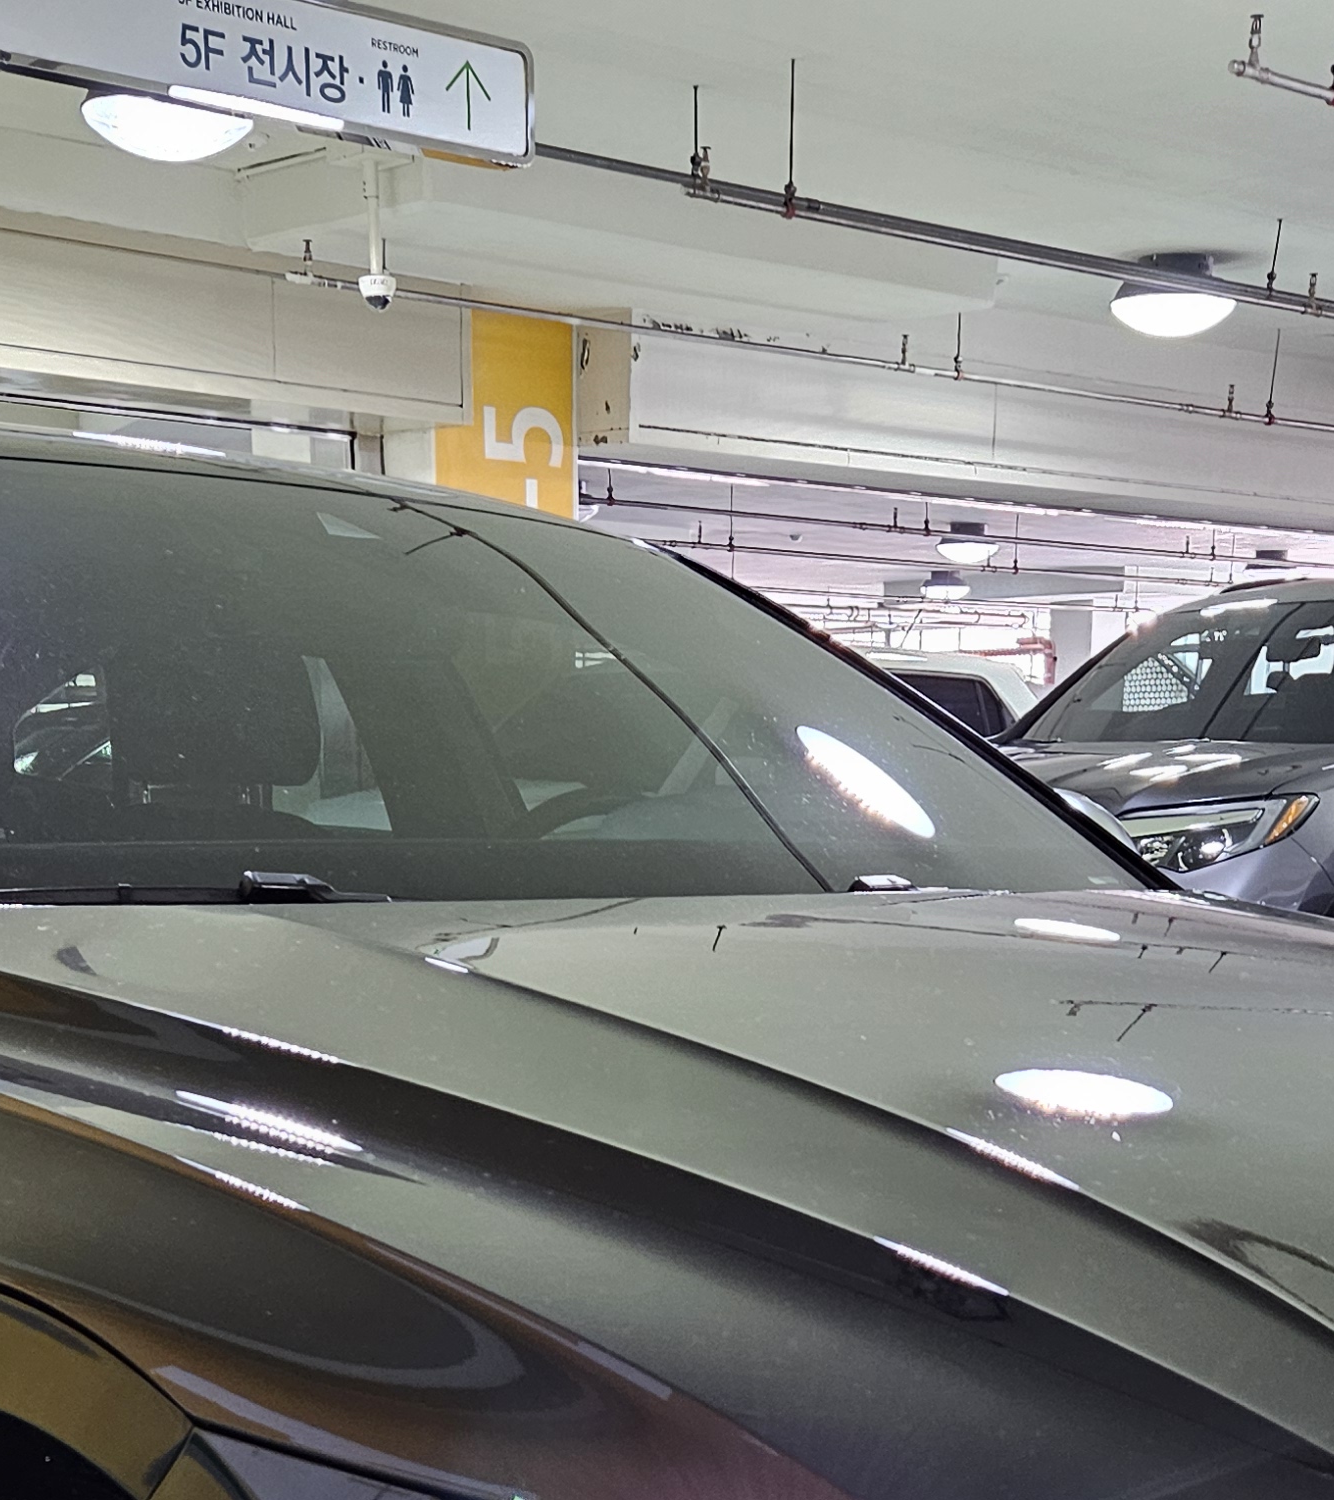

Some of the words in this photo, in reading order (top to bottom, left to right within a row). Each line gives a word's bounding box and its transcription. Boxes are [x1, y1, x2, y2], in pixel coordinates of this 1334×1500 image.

[196, 0, 264, 23] EXHIBITION
[267, 12, 298, 31] HALL
[179, 22, 225, 72] 5F
[240, 34, 349, 104] 전시장
[371, 37, 420, 58] RESTROOM
